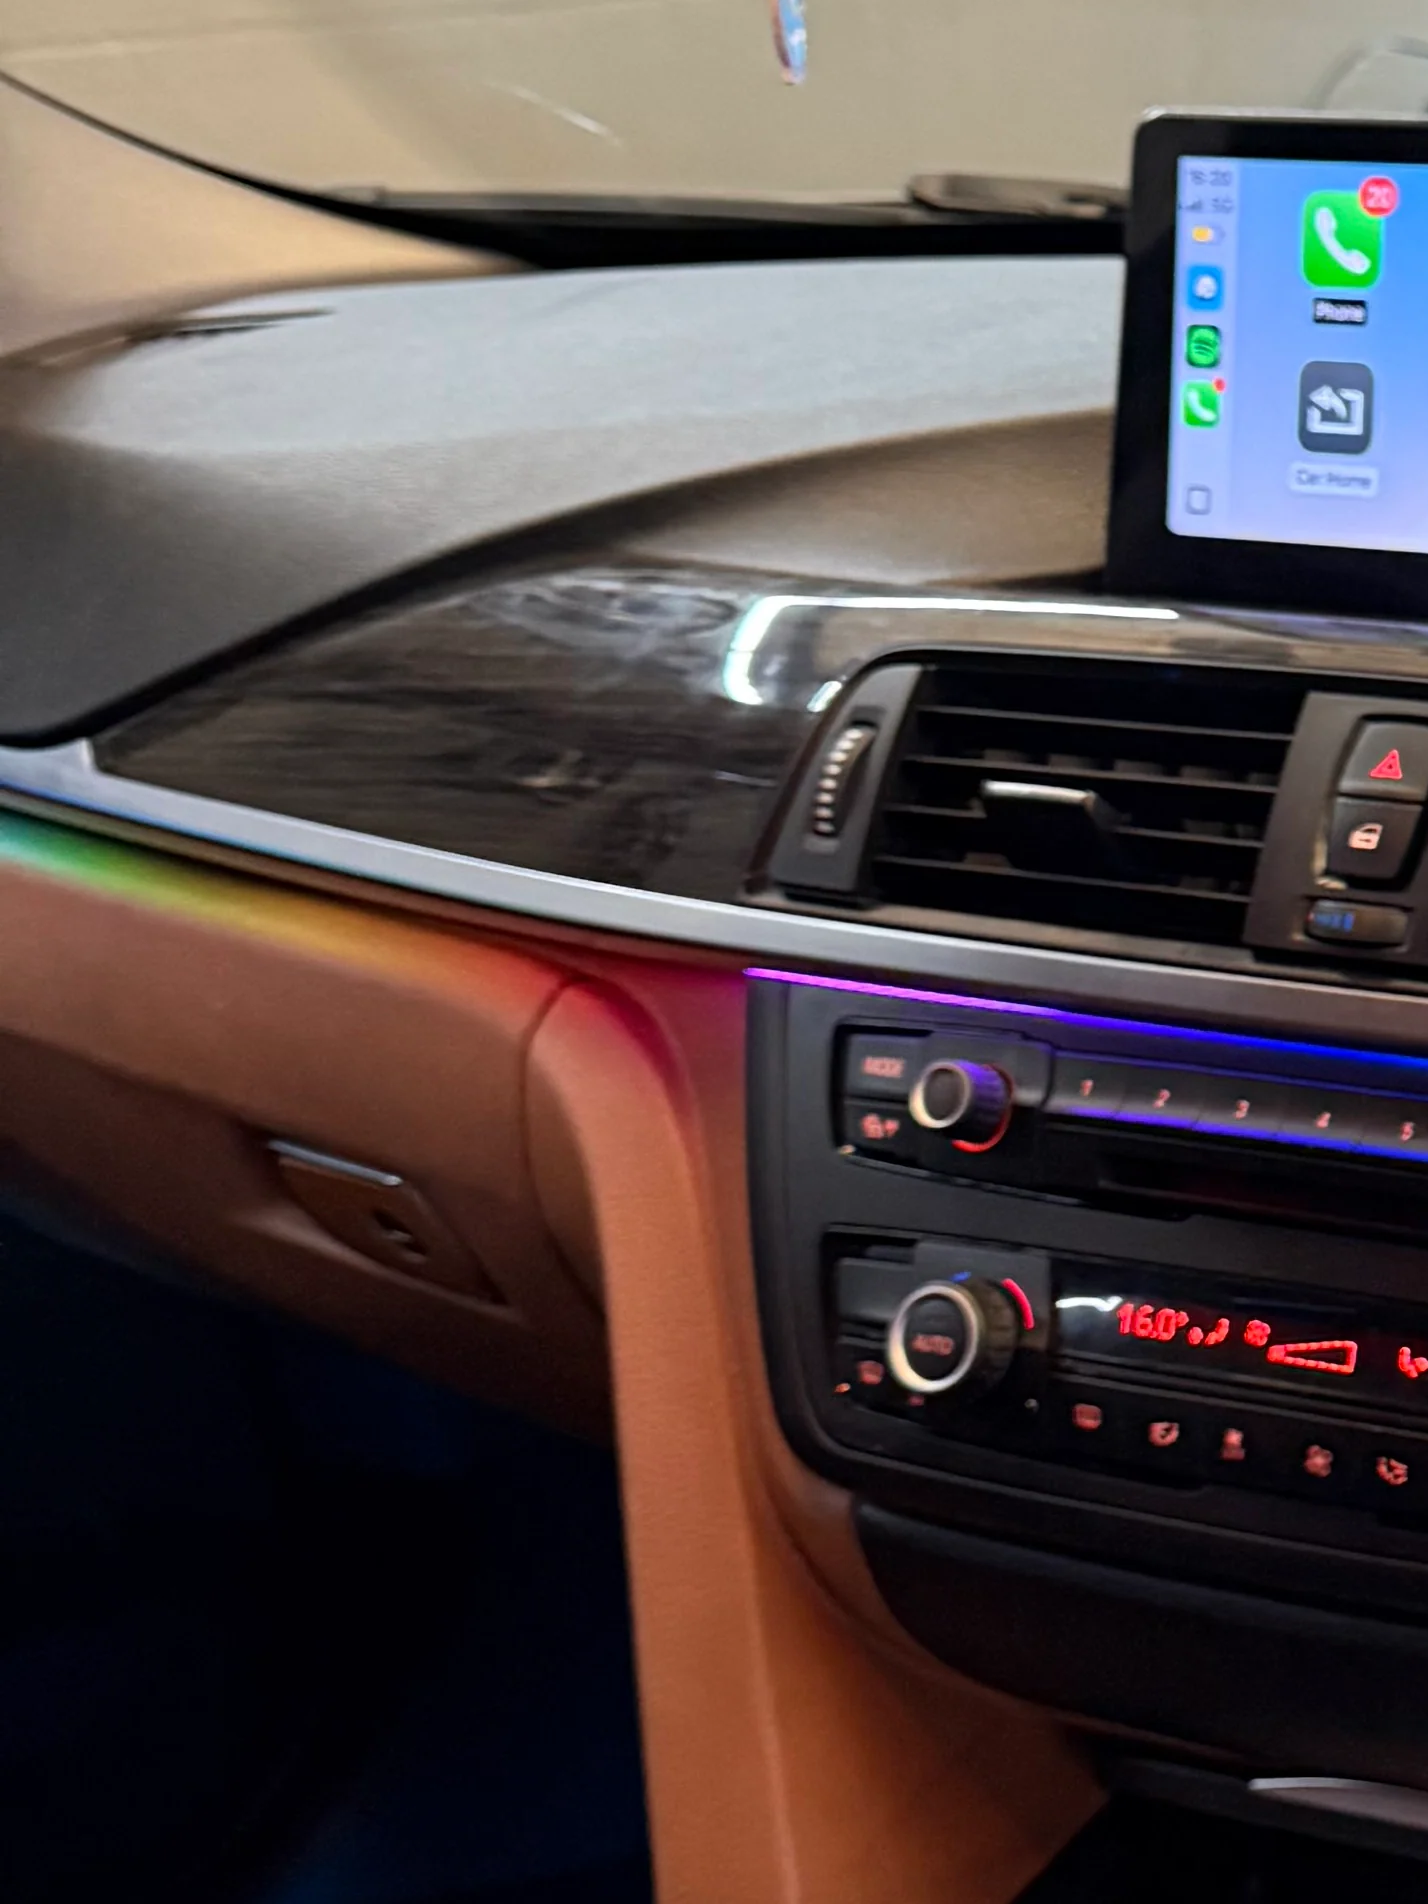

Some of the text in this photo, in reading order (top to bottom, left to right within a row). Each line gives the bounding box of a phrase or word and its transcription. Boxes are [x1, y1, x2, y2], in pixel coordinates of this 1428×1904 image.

[1315, 300, 1365, 323] Phone
[1153, 1089, 1171, 1108] 2
[1234, 1100, 1251, 1120] 3
